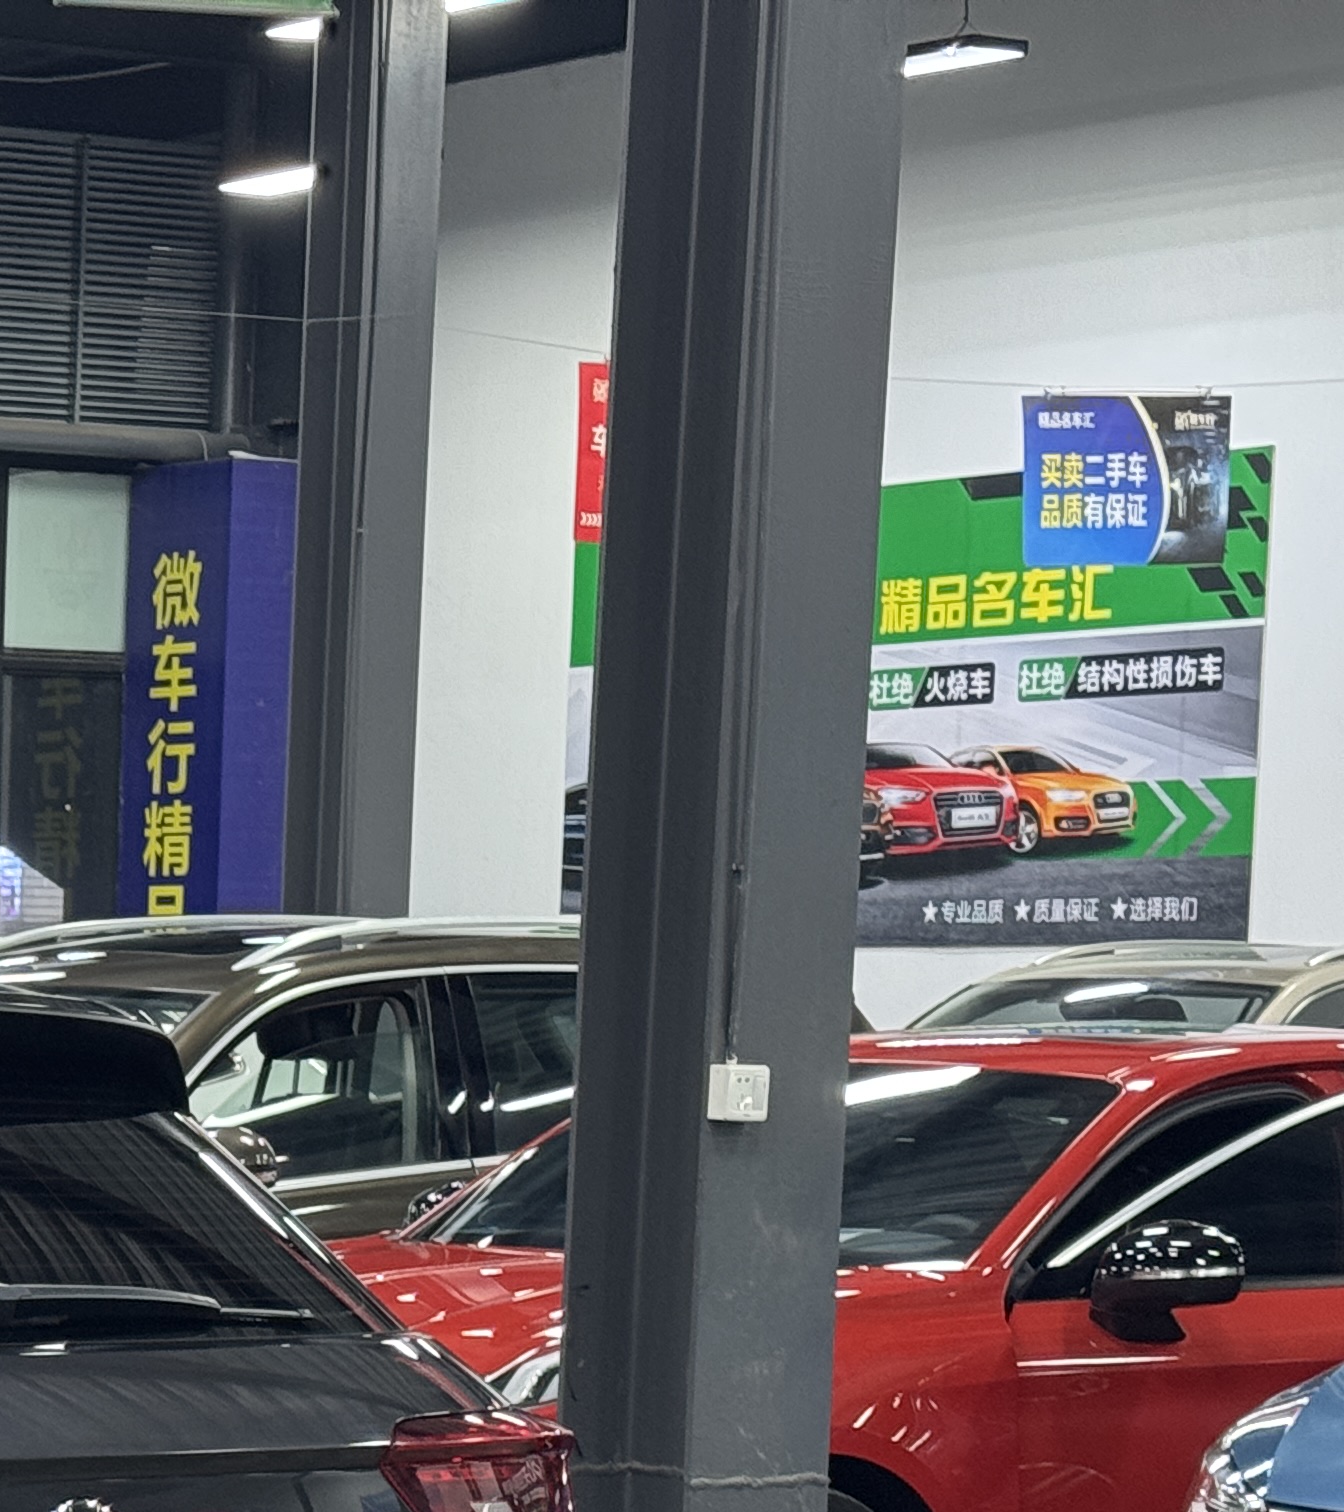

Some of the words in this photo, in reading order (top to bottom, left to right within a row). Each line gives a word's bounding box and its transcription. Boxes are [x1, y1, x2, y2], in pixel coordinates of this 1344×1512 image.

[1041, 452, 1148, 489] 买卖二手车
[1040, 493, 1148, 529] 品质有保证
[880, 564, 1114, 635] 精品名车汇
[869, 672, 914, 707] 杜绝
[926, 667, 992, 702] 火烧车
[1018, 662, 1067, 697] 杜绝
[1077, 653, 1224, 693] 结构性损伤车
[940, 899, 1004, 924] 专业品质
[1032, 898, 1100, 923] 质量保证
[1128, 896, 1198, 922] 选择我们
